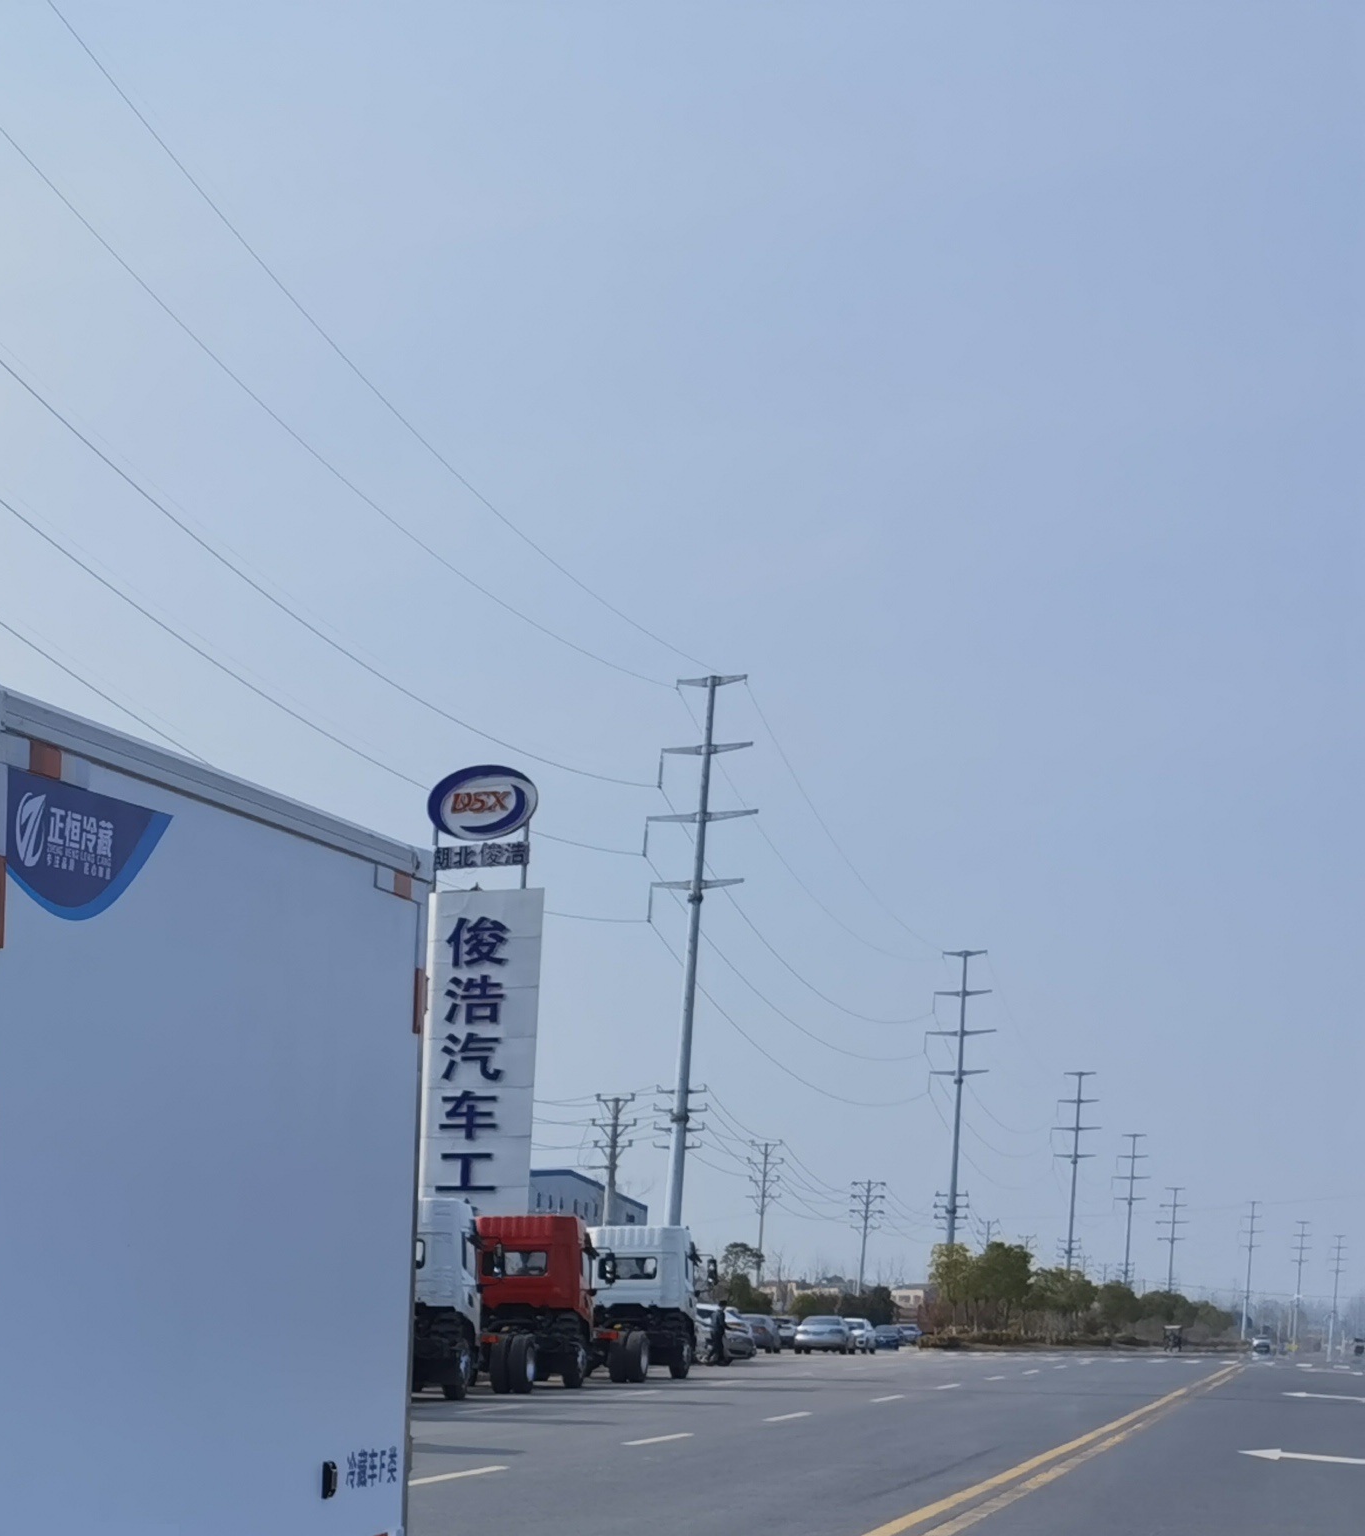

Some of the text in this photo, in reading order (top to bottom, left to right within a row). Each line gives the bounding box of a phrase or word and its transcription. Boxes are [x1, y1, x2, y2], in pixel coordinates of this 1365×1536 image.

[47, 806, 114, 858] 正恒冷藏
[435, 916, 511, 1212] 俊浩汽车工
